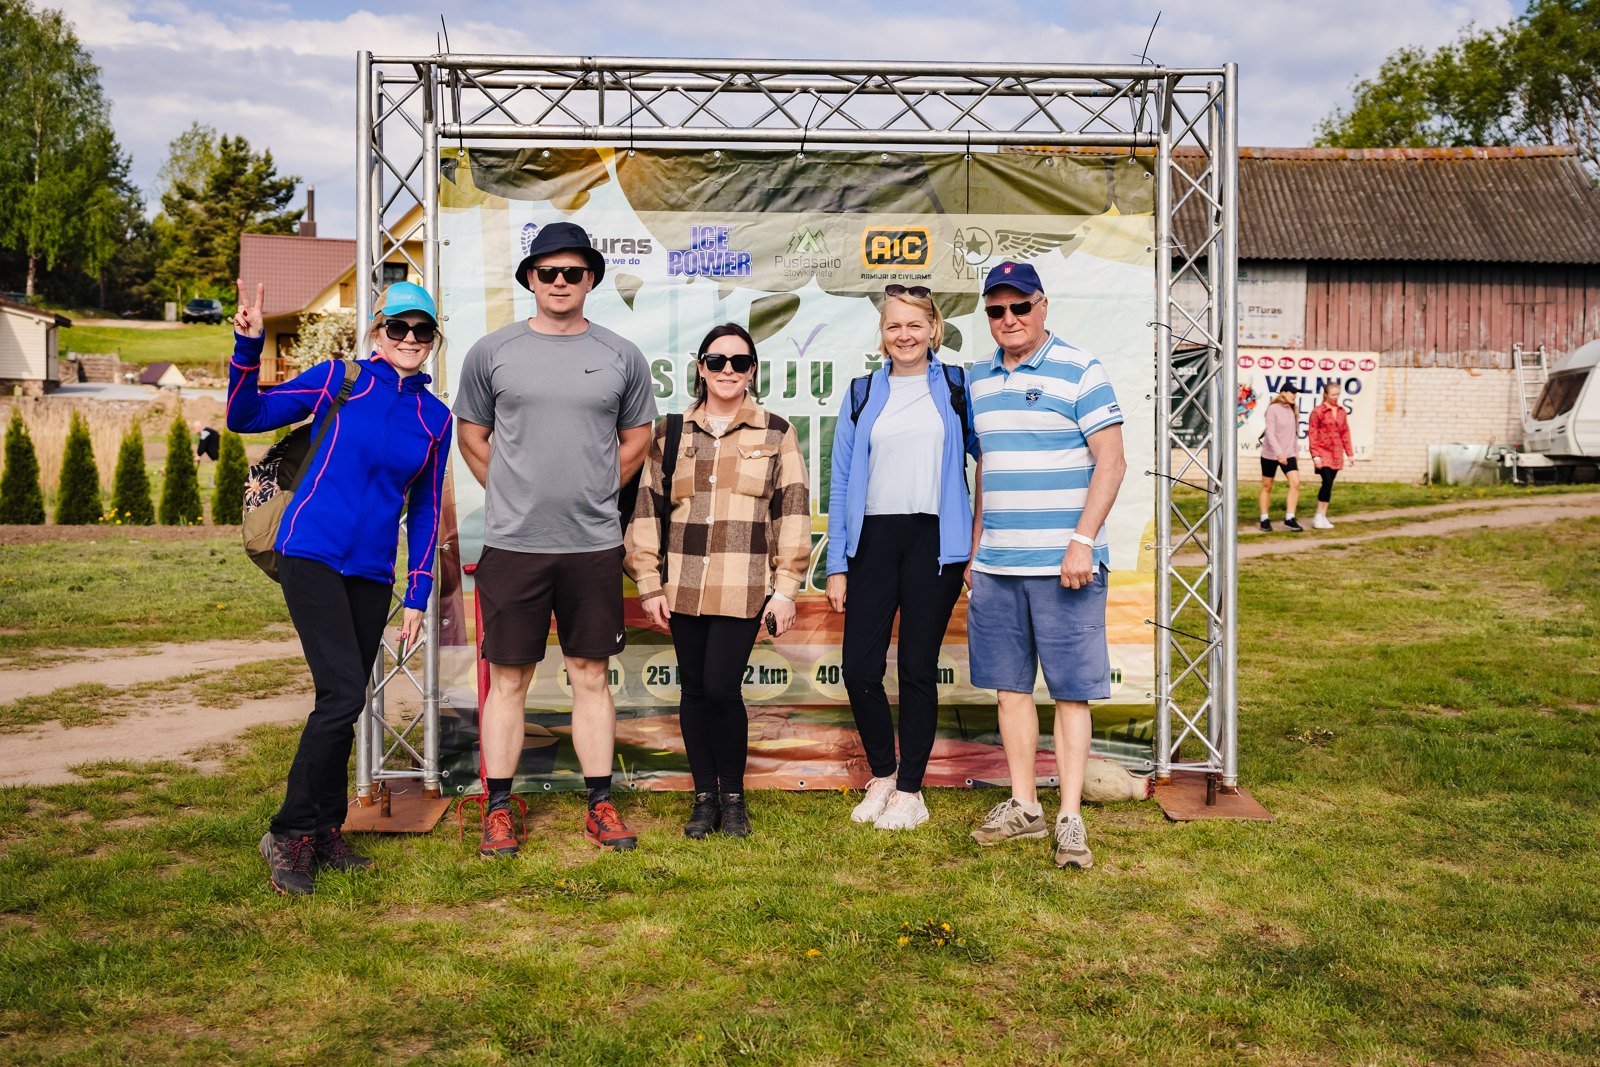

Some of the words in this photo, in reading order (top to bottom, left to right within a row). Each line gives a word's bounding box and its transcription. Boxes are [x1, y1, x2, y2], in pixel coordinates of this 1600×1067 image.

[587, 233, 653, 255] uras
[690, 225, 729, 251] ICE
[871, 236, 922, 260] AIC
[628, 257, 641, 265] do
[667, 250, 752, 277] POWER
[967, 267, 991, 280] LIF
[1248, 306, 1282, 315] PTuras
[647, 665, 671, 685] 25
[759, 665, 788, 685] km
[815, 664, 840, 685] 40
